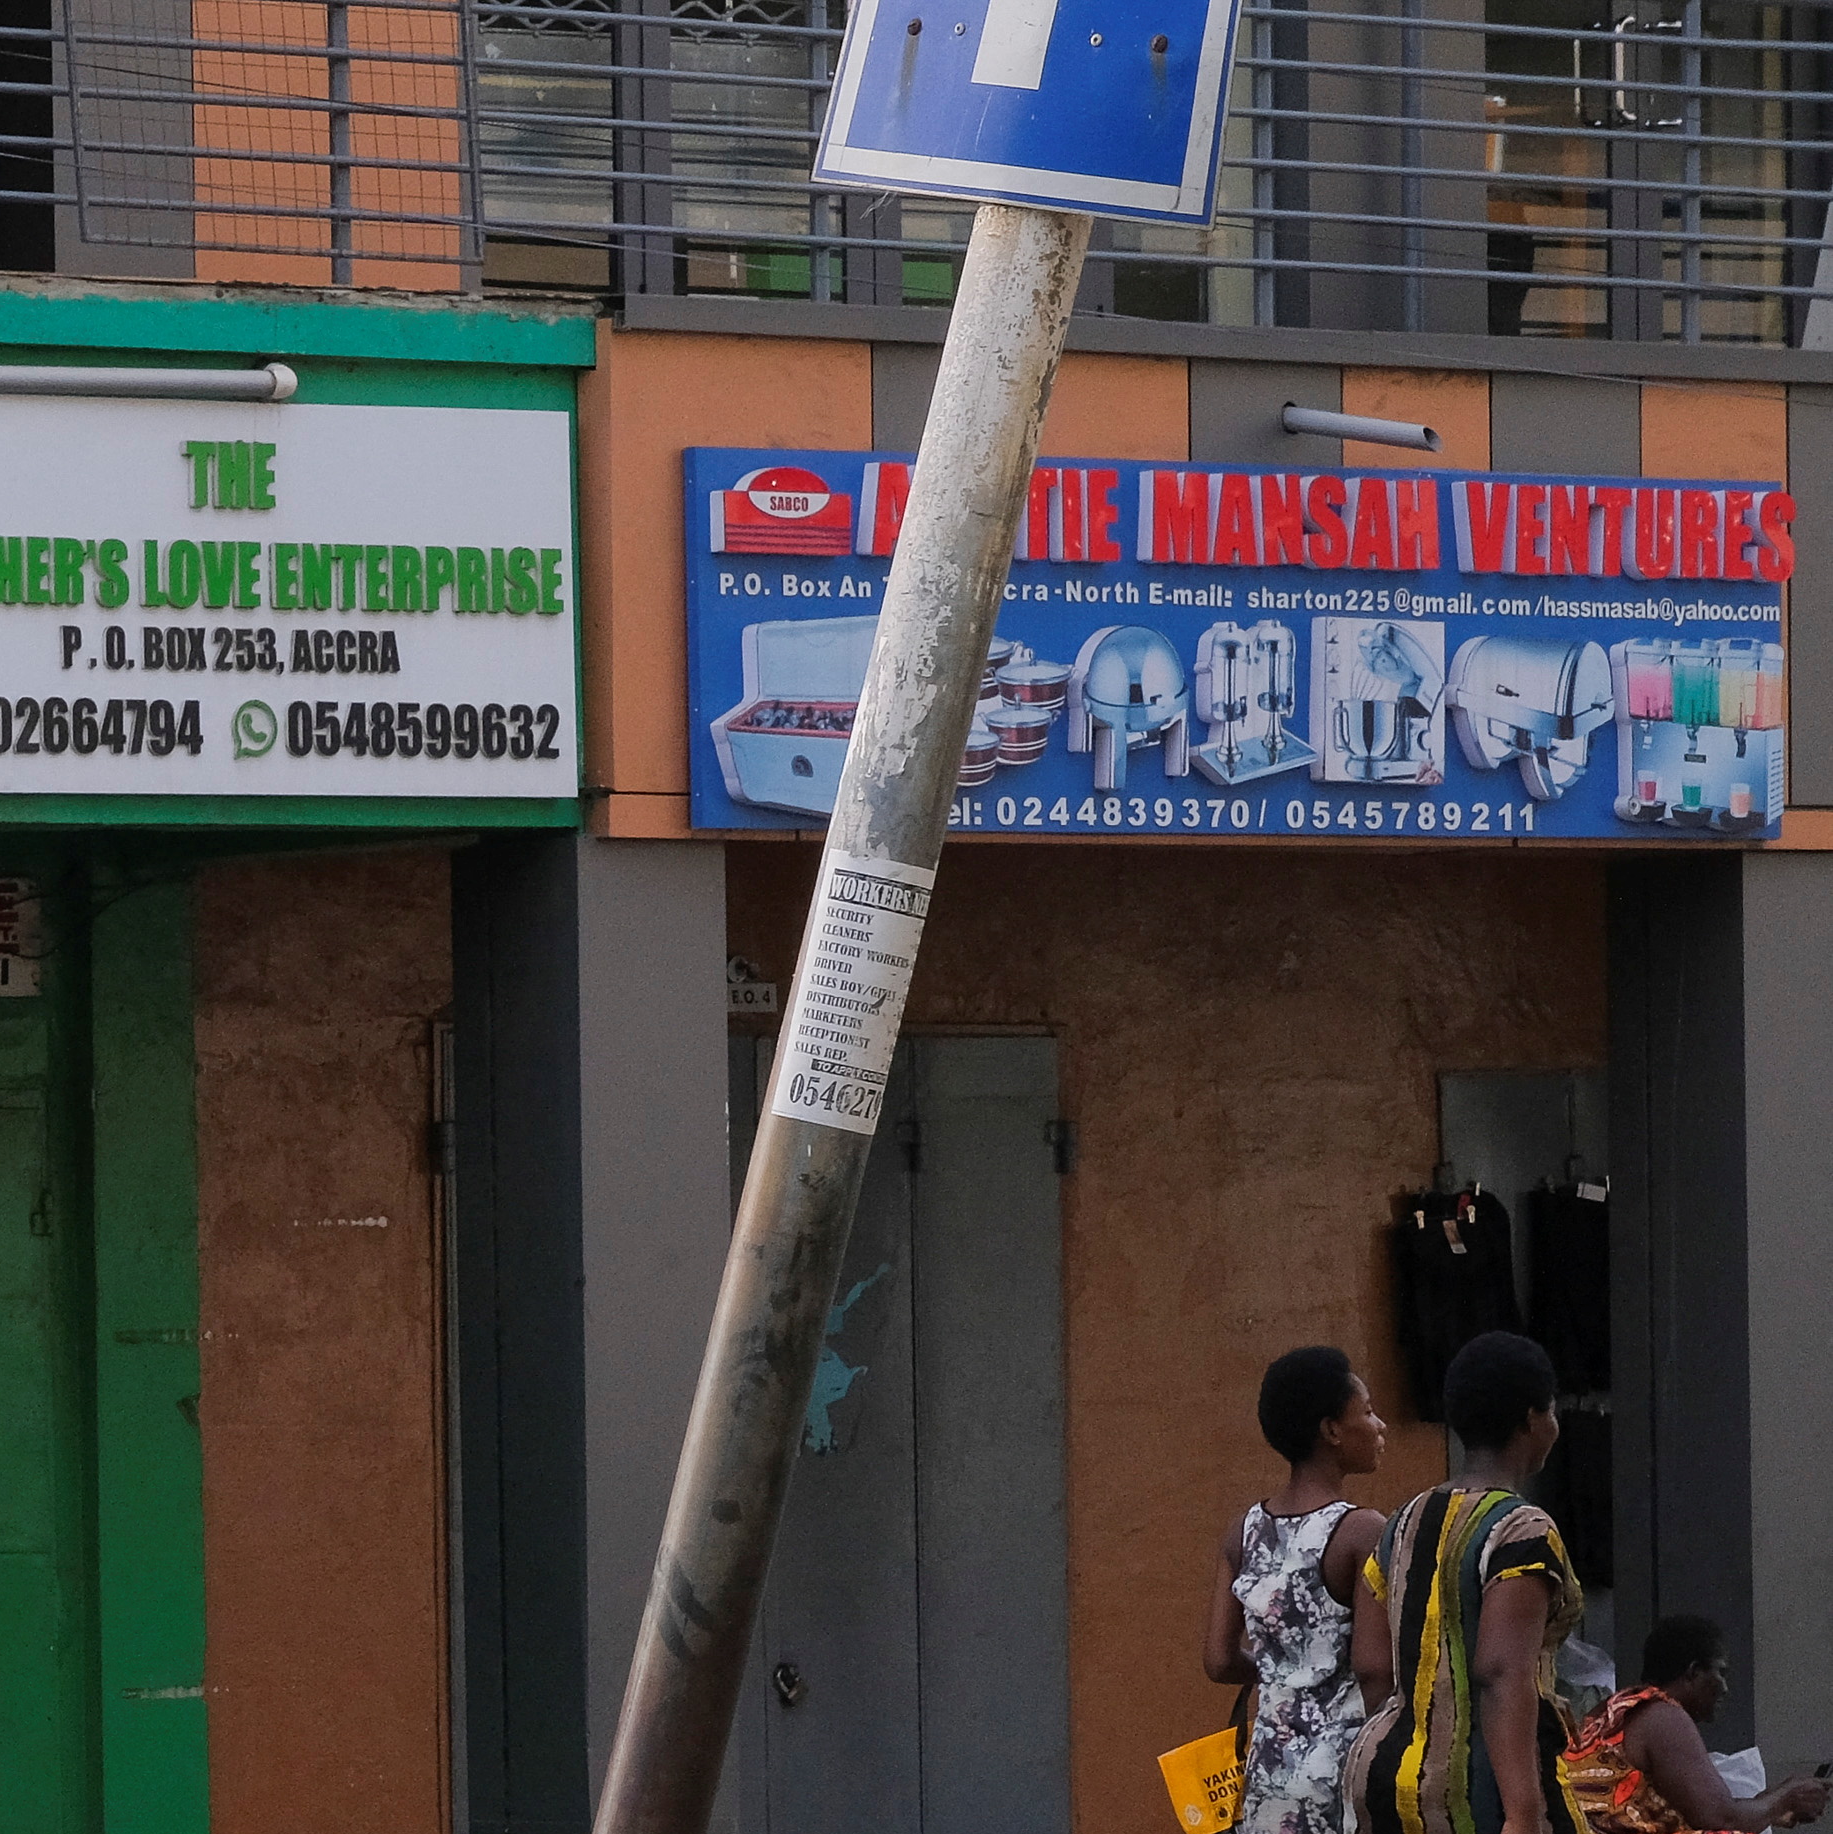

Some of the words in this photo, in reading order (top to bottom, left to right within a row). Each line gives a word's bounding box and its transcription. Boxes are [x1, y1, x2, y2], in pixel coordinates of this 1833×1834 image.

[181, 439, 277, 511] THE
[769, 495, 809, 512] SABCO
[856, 462, 1121, 563] ATIE
[1137, 469, 1439, 570] MANSAH
[1452, 481, 1796, 583] VENTURES
[140, 539, 262, 611] LOVE
[269, 542, 565, 616] ENTERPRISE
[719, 572, 771, 596] P.O.
[783, 574, 832, 598] Box
[838, 574, 872, 598] An
[1148, 582, 1233, 608] E-mail:
[141, 625, 208, 672] BOX
[289, 628, 401, 674] ACCRA
[285, 700, 561, 761] 0548599632
[947, 796, 982, 826] el:
[1285, 799, 1534, 832] 0545789211
[829, 874, 912, 913] WORKERS
[822, 923, 873, 943] CLEANERS
[826, 905, 874, 925] SECURITY
[814, 956, 853, 974] DRIVER
